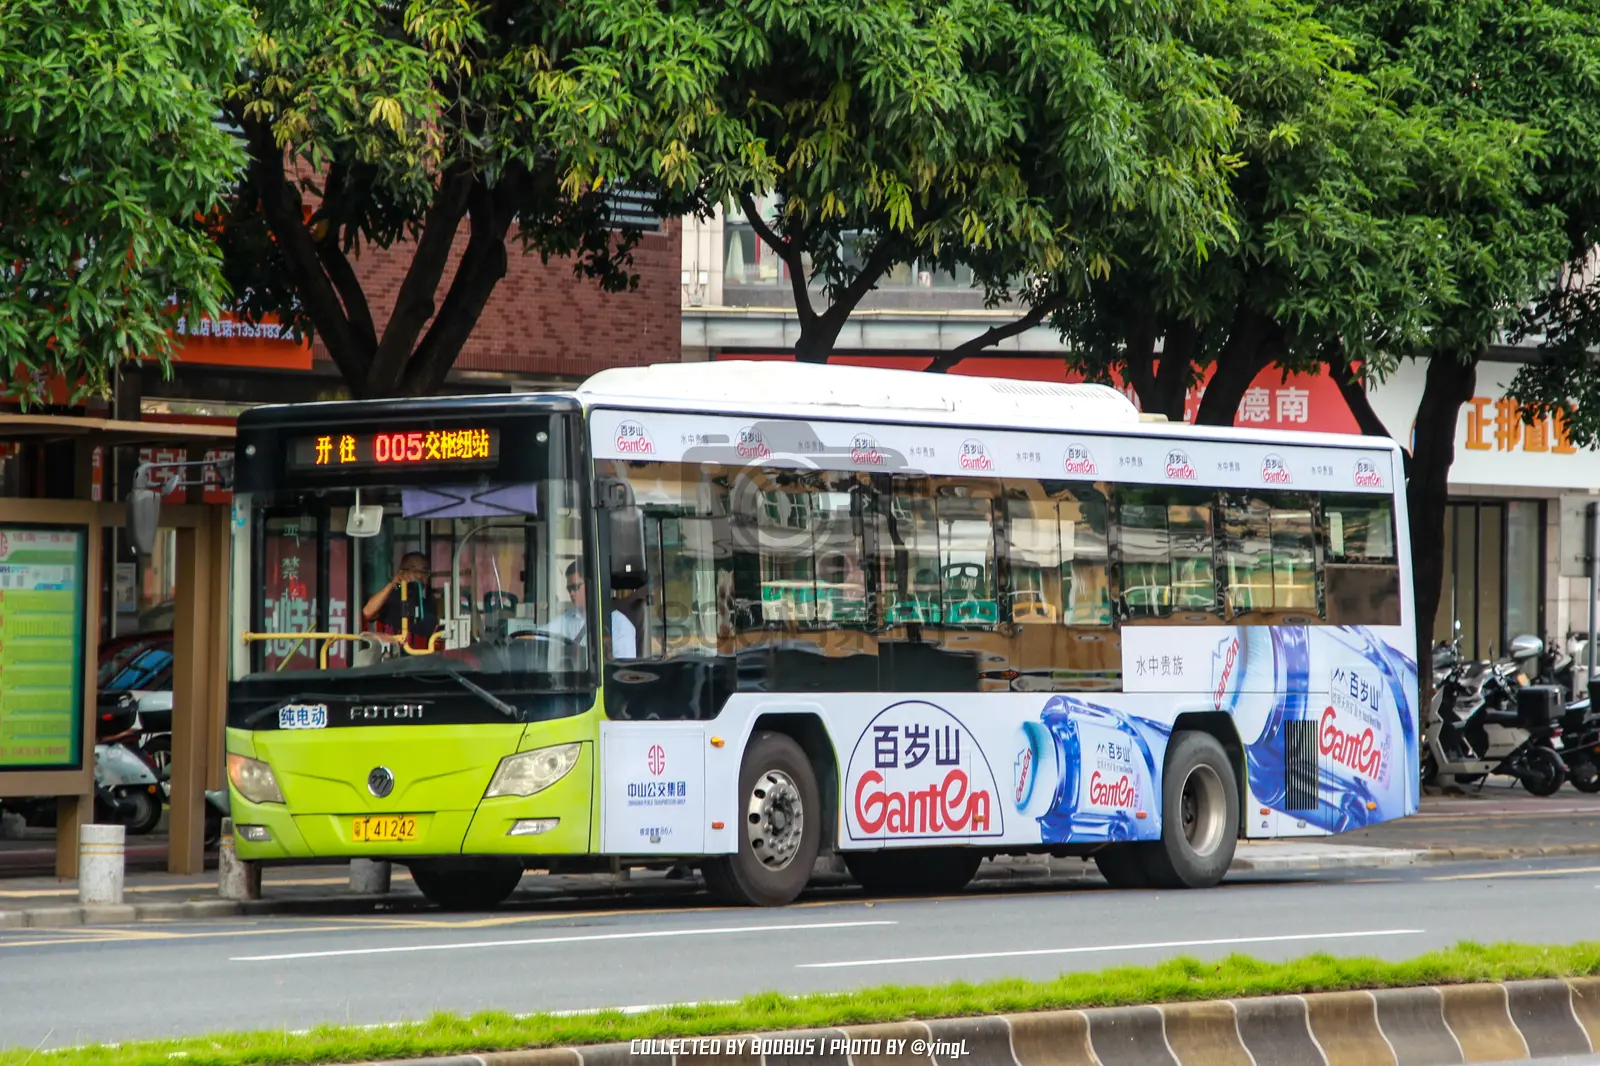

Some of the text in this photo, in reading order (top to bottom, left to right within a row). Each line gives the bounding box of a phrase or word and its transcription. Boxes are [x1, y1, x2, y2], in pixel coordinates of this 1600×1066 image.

[620, 425, 643, 436] 百岁山
[740, 432, 763, 442] 百岁山
[315, 429, 489, 464] 开往 005 交枢纽站
[854, 438, 876, 449] 百岁山
[963, 444, 984, 454] 百岁山
[1068, 448, 1088, 458] 百岁山
[1136, 655, 1184, 677] 水中贵族
[1350, 671, 1379, 712] 百岁山
[279, 705, 326, 727] 纯电动
[873, 724, 960, 769] 百岁山
[1108, 742, 1130, 762] 百岁山
[627, 781, 686, 797] 中山公交集团
